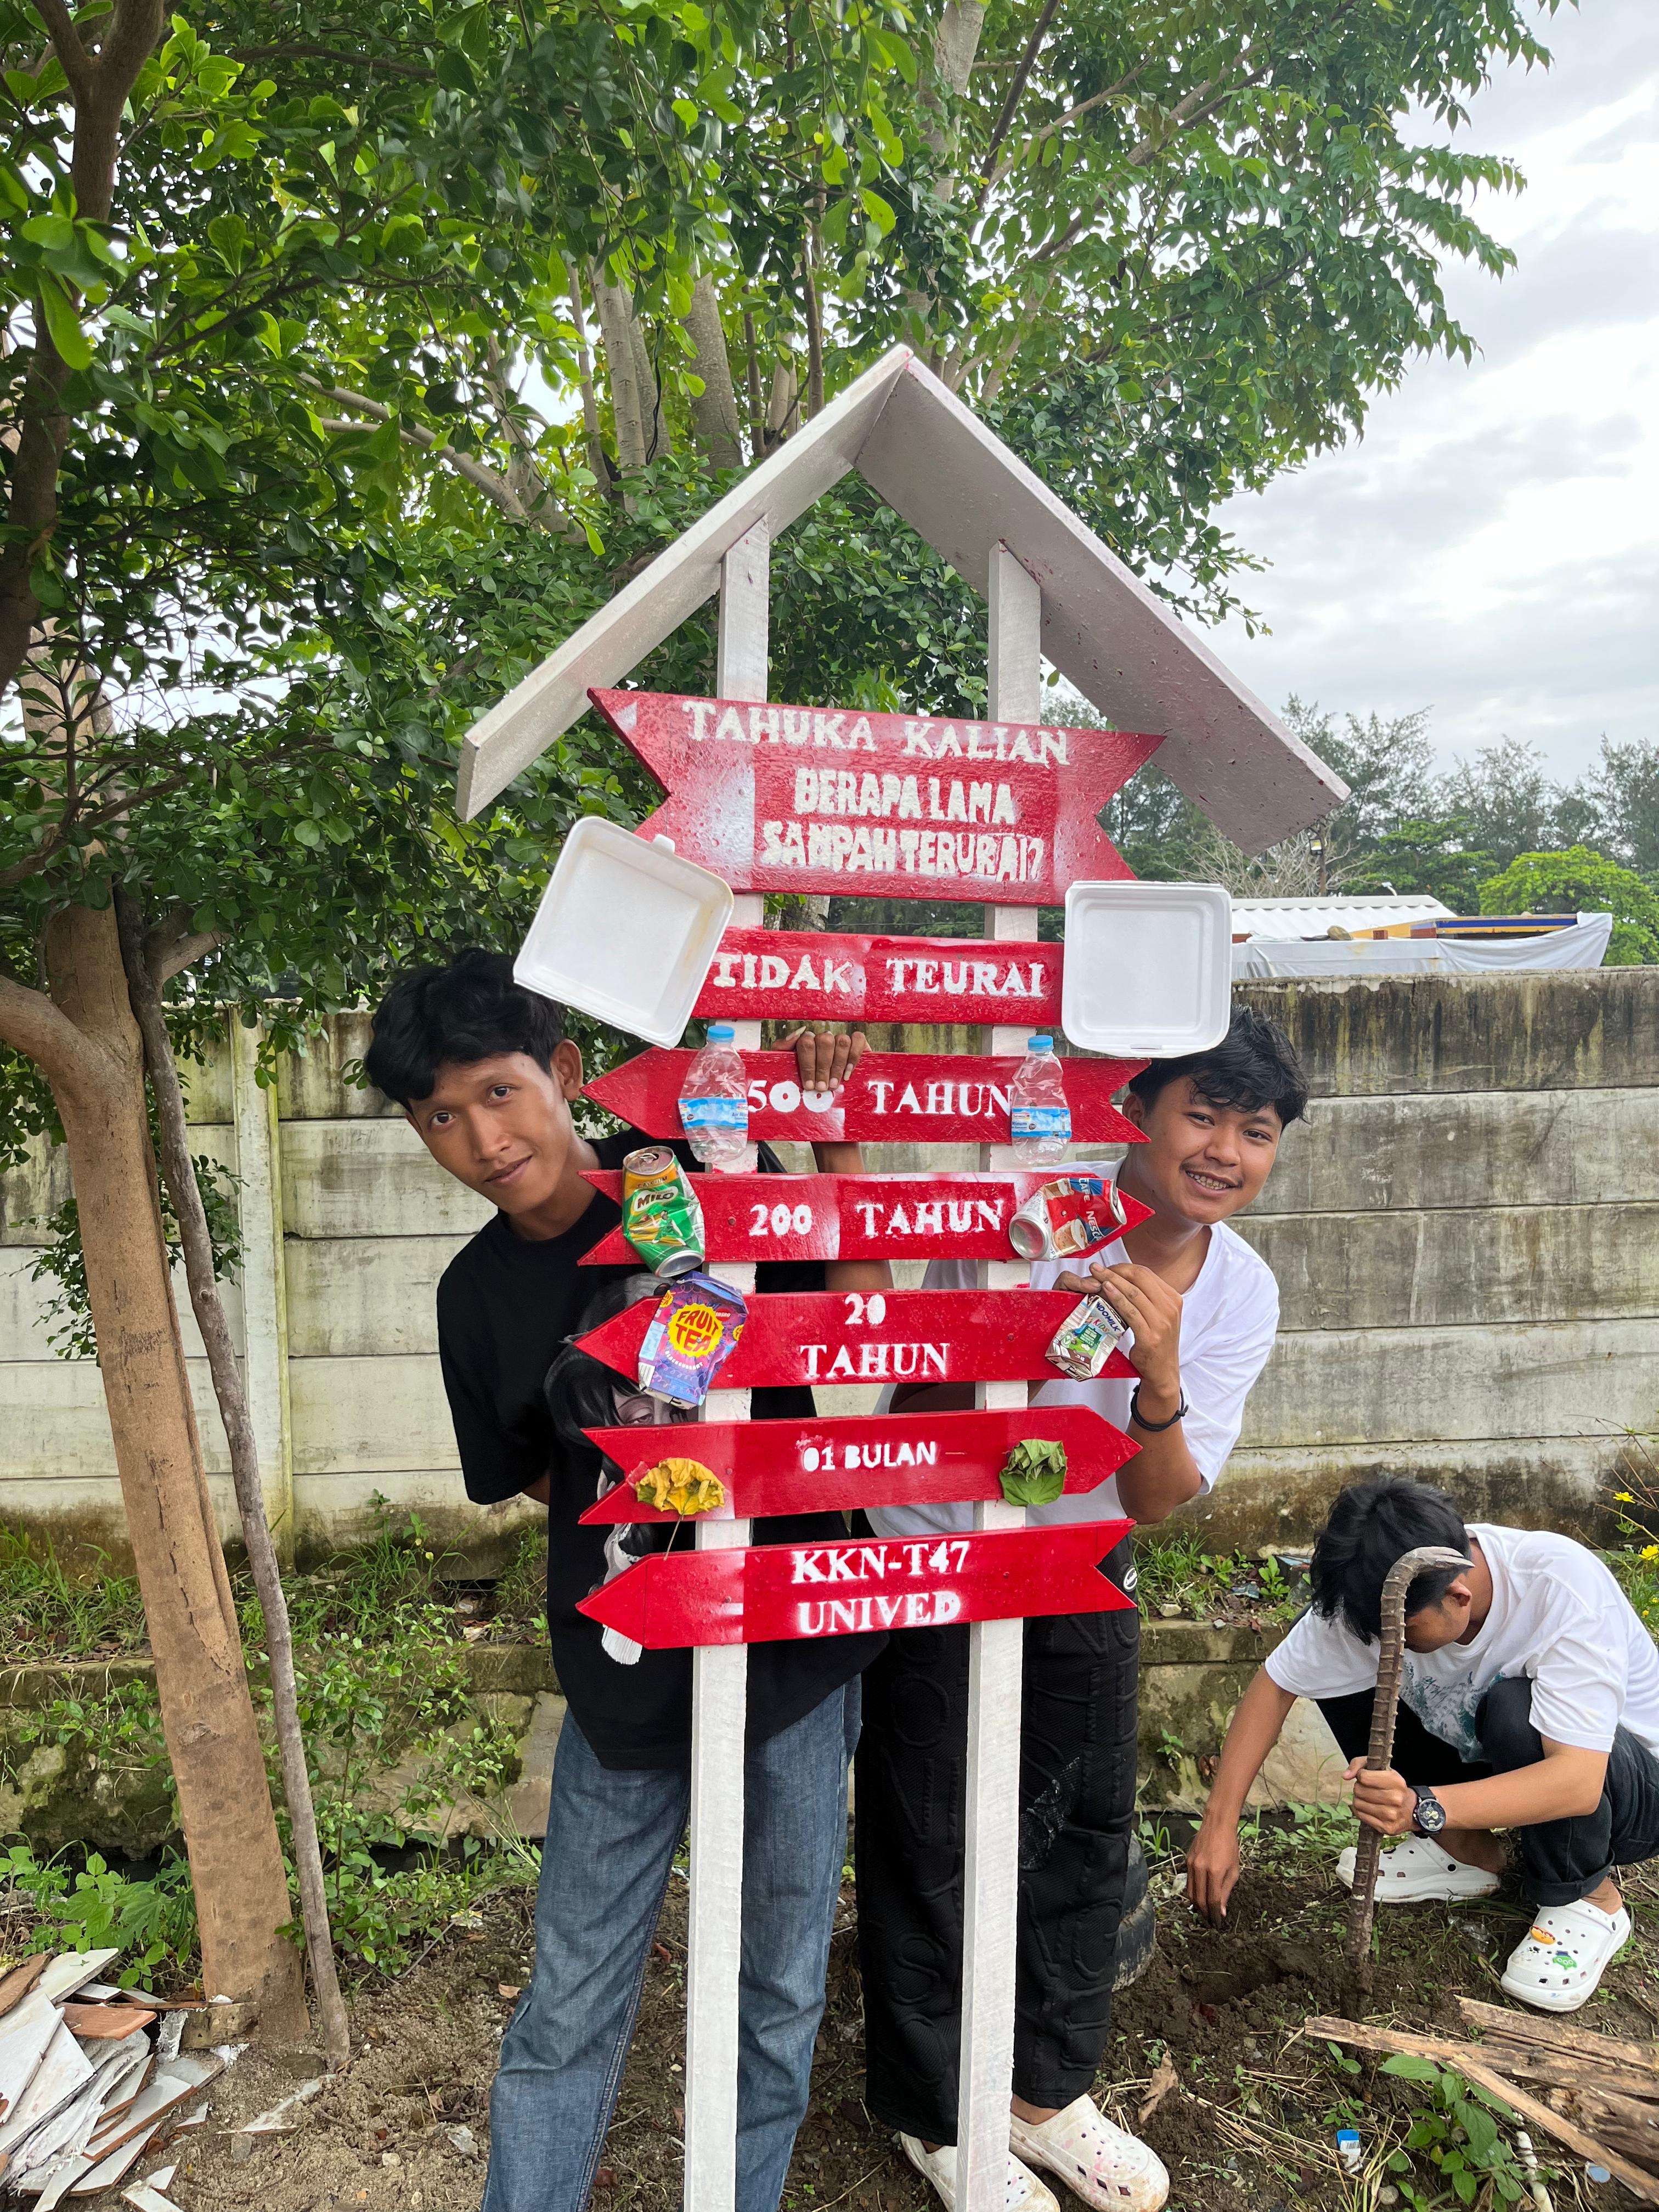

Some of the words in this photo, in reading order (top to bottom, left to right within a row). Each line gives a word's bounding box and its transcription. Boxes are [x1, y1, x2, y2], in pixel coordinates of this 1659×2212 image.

[682, 701, 877, 752] TAHUKA
[901, 720, 1070, 769] KALIAN
[794, 768, 923, 820] BERAPA
[928, 777, 1015, 825] LAMA
[712, 952, 852, 993] TIDAK
[886, 960, 1045, 997] TEURAI
[868, 1081, 1015, 1116] TAHUN
[637, 1192, 674, 1209] MILO
[748, 1204, 812, 1236] 200
[855, 1200, 1004, 1239] TAHUN
[677, 1310, 719, 1336] FRUIT
[844, 1293, 886, 1326] 20
[1096, 1301, 1120, 1332] NDOMILK
[675, 1323, 712, 1352] TEA
[665, 1350, 703, 1371] BLACKCURRANT
[799, 1342, 950, 1379] TAHUN
[844, 1441, 936, 1469] BULAN
[791, 1540, 970, 1584] KKN-T47
[797, 1590, 961, 1634] UNIVED
